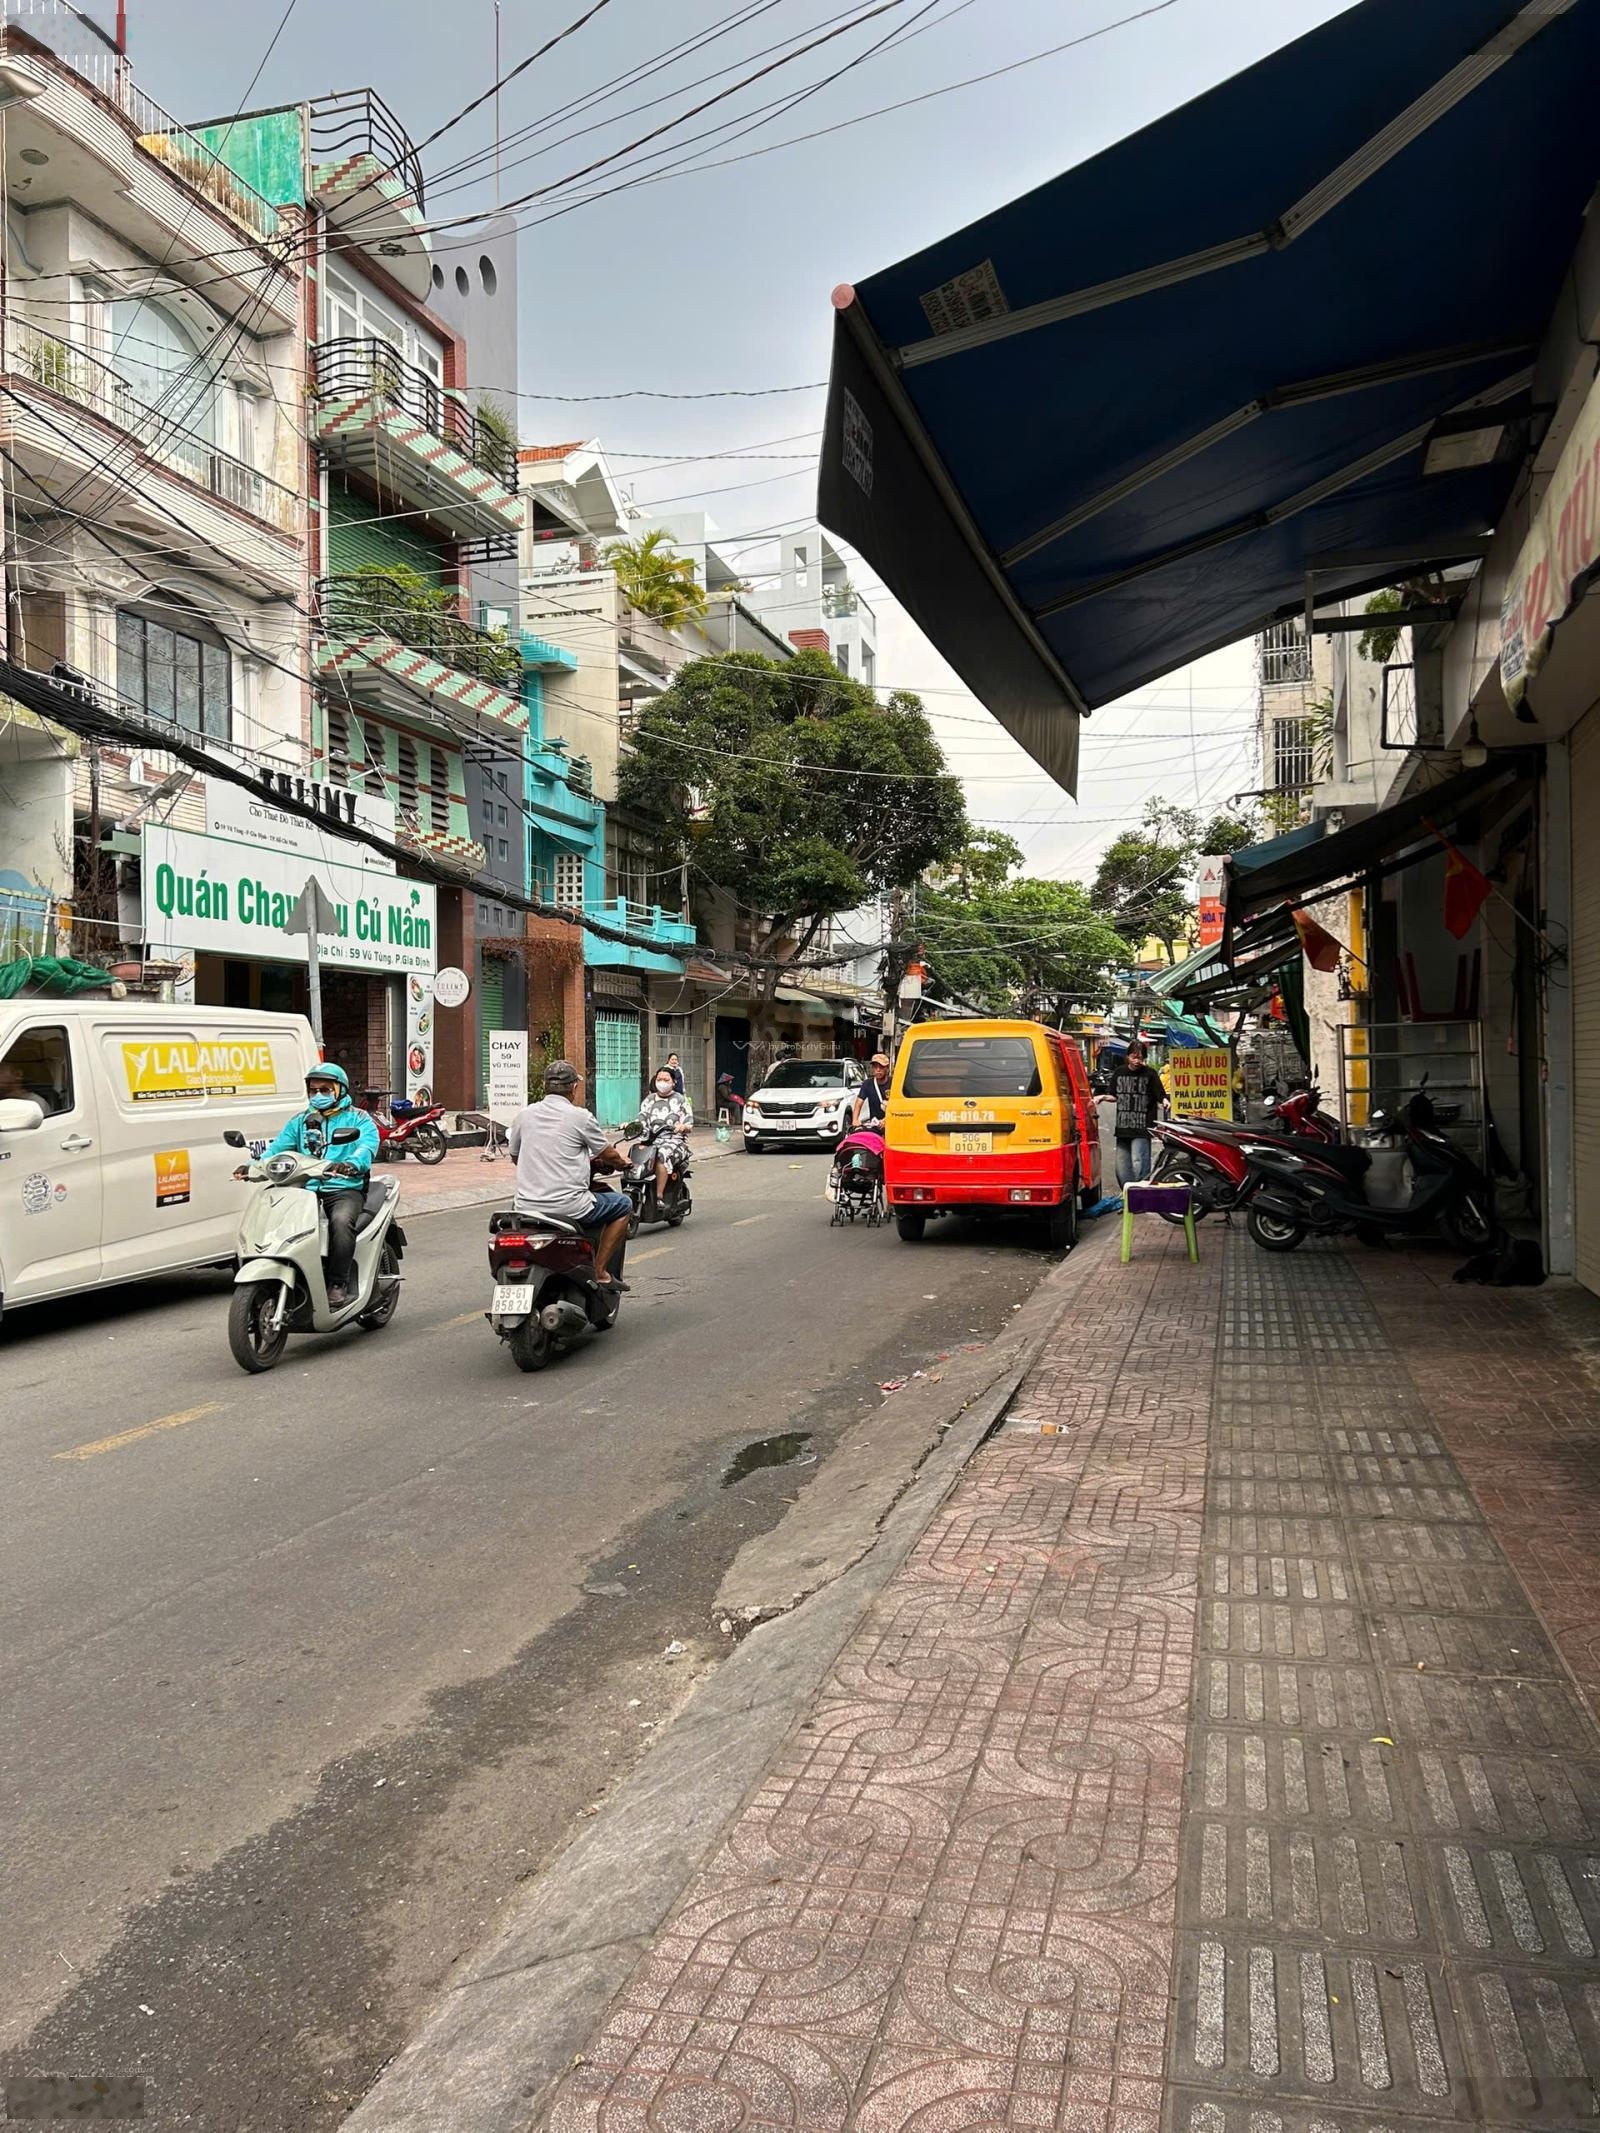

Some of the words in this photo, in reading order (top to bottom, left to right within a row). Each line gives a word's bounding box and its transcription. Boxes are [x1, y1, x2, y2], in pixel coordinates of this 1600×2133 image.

[249, 805, 262, 818] Cho
[156, 863, 228, 921] Quán
[355, 897, 381, 943] Củ
[350, 948, 361, 959] 59
[491, 1042, 521, 1050] CHAY
[153, 1046, 271, 1075] LALAMOVE
[938, 1110, 995, 1122] 50G-010.78
[962, 1133, 979, 1142] 50G
[955, 1143, 987, 1152] 010.78
[500, 1287, 526, 1299] 59-G1
